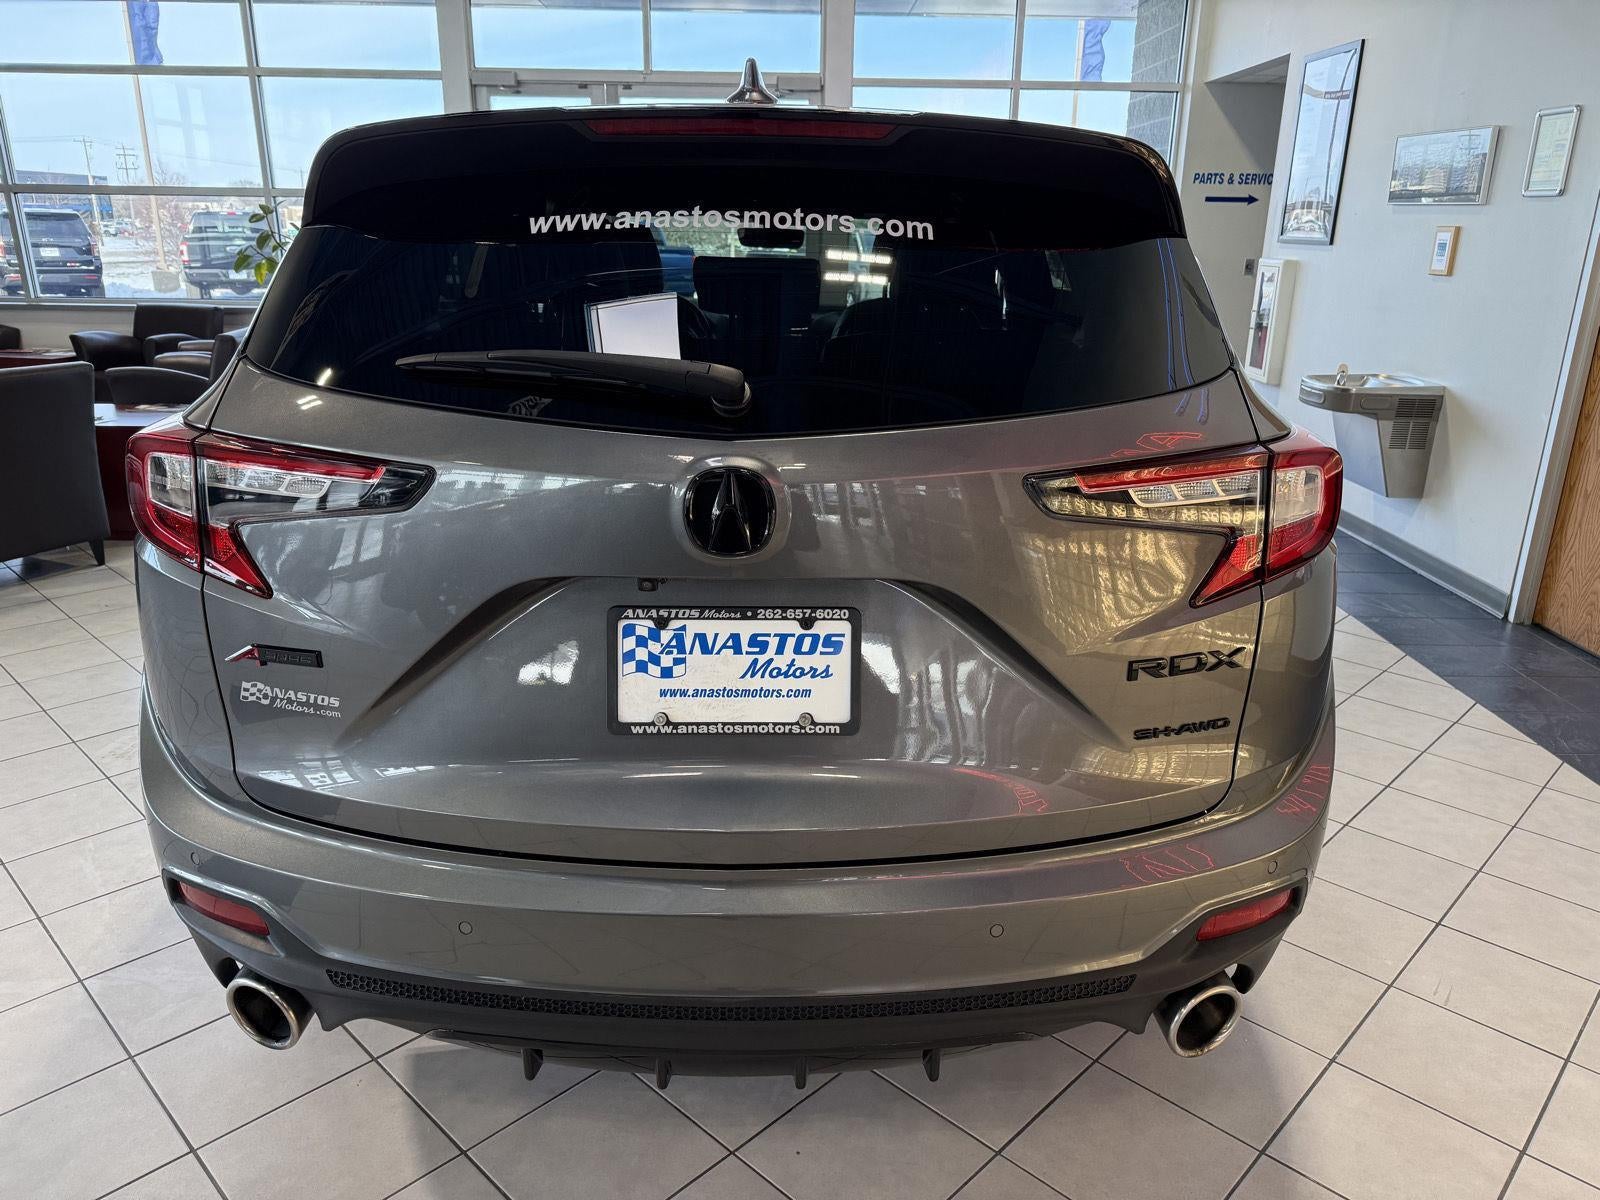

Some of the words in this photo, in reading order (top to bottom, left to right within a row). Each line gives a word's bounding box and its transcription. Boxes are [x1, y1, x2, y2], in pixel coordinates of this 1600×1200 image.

[1193, 173, 1225, 185] PARTS
[1227, 173, 1235, 185] &
[529, 205, 935, 241] www.anastosmotors.com
[621, 608, 701, 619] ANASTOS
[700, 609, 742, 619] Motors
[756, 609, 850, 619] 262-657-6020
[658, 632, 846, 656] ANASTOS
[738, 657, 834, 680] Motors
[1126, 646, 1247, 682] RDX
[261, 685, 340, 708] ANASTOS
[659, 686, 812, 699] www.anastosmotors.com
[630, 723, 841, 735] www.anastosmotors.com
[1133, 717, 1231, 741] SH-AWD
